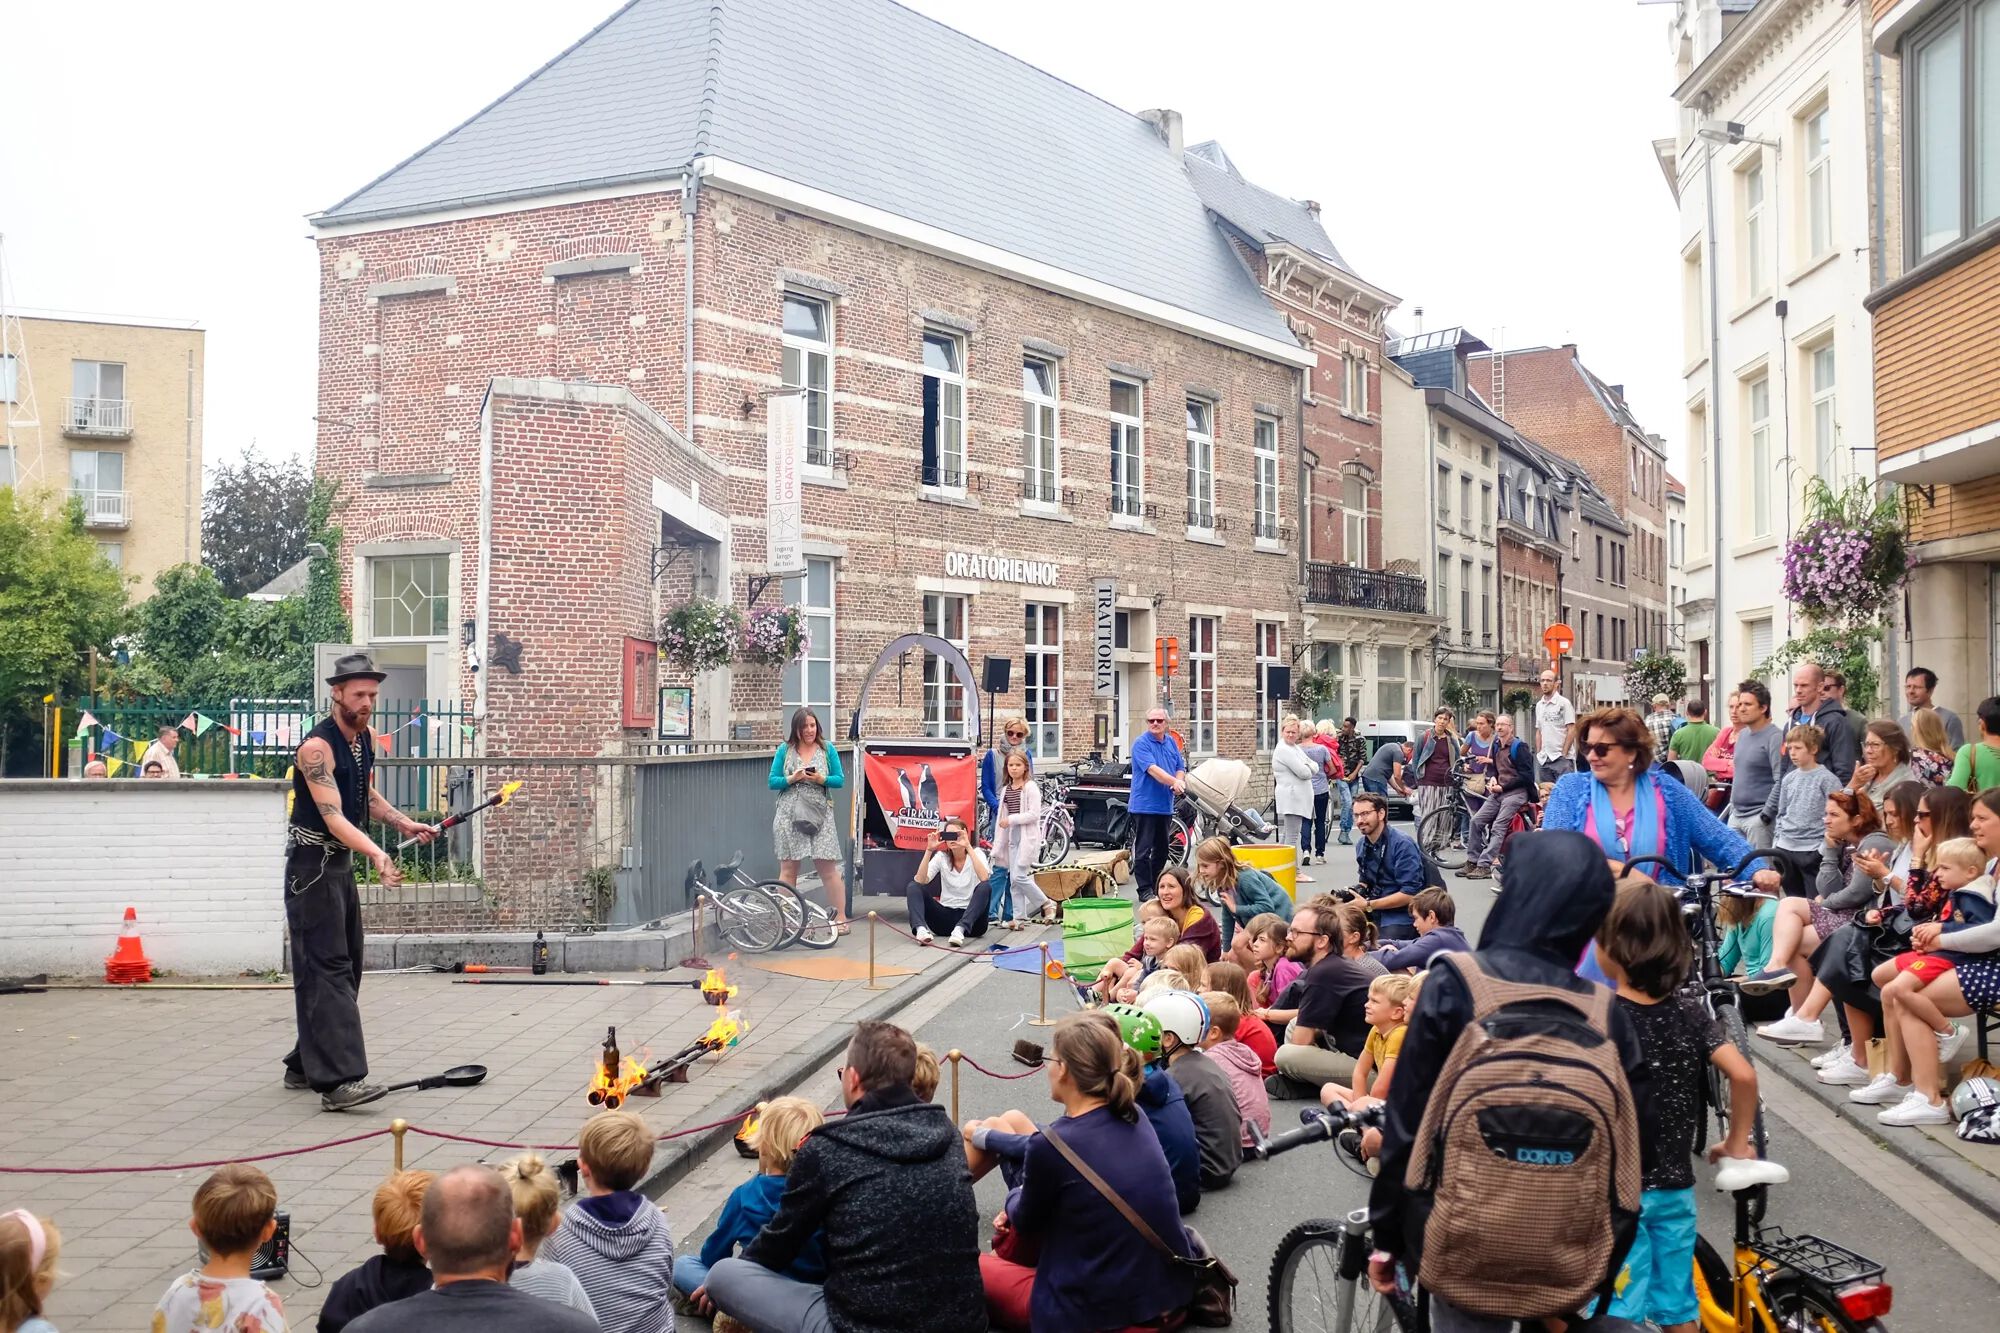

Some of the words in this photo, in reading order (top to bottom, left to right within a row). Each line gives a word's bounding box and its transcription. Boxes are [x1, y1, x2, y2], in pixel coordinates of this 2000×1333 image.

[944, 551, 1060, 586] ORATORIENHOF
[1097, 585, 1112, 690] TRATTORIA
[899, 807, 940, 819] CIRKUS
